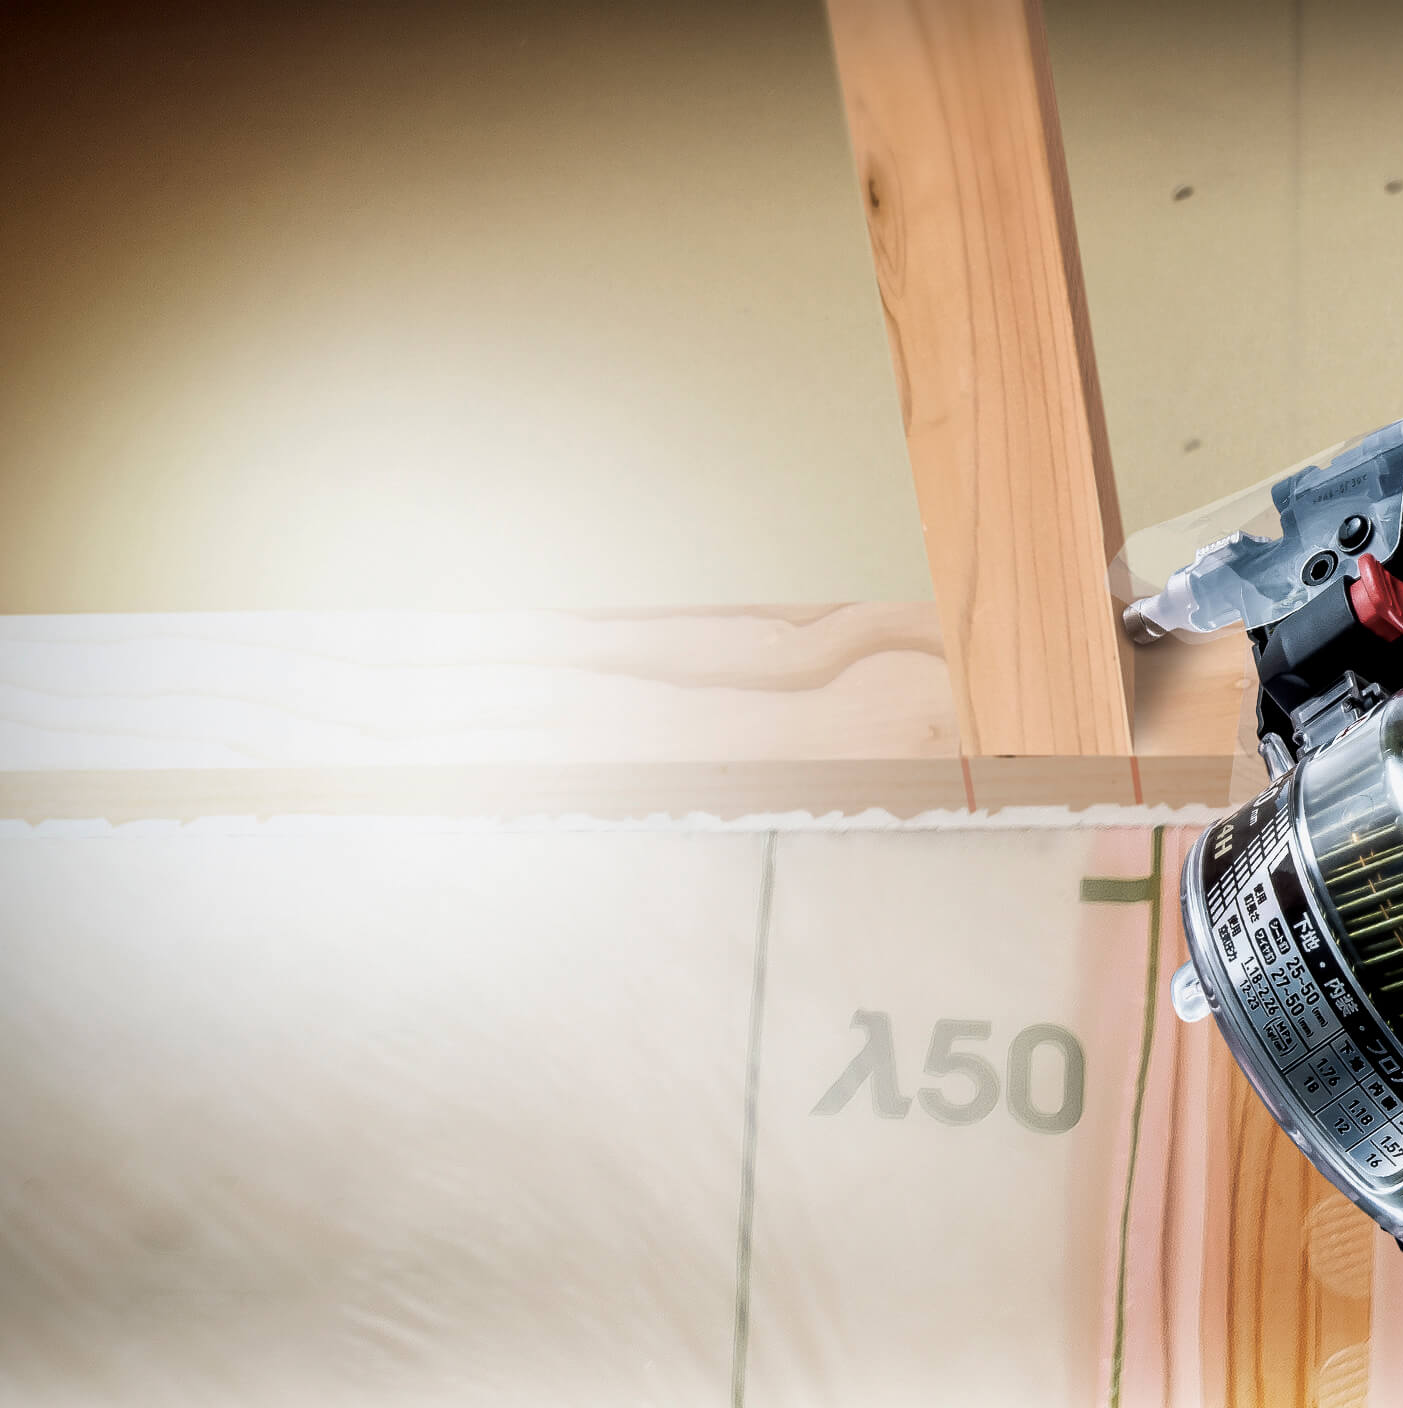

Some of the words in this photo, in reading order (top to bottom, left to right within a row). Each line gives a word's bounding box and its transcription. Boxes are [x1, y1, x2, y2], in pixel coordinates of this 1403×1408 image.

[1316, 1057, 1341, 1087] 1.76
[1303, 1076, 1320, 1093] 18
[1348, 1100, 1374, 1126] 1.18
[1334, 1117, 1350, 1135] 12
[1365, 1153, 1383, 1168] 16
